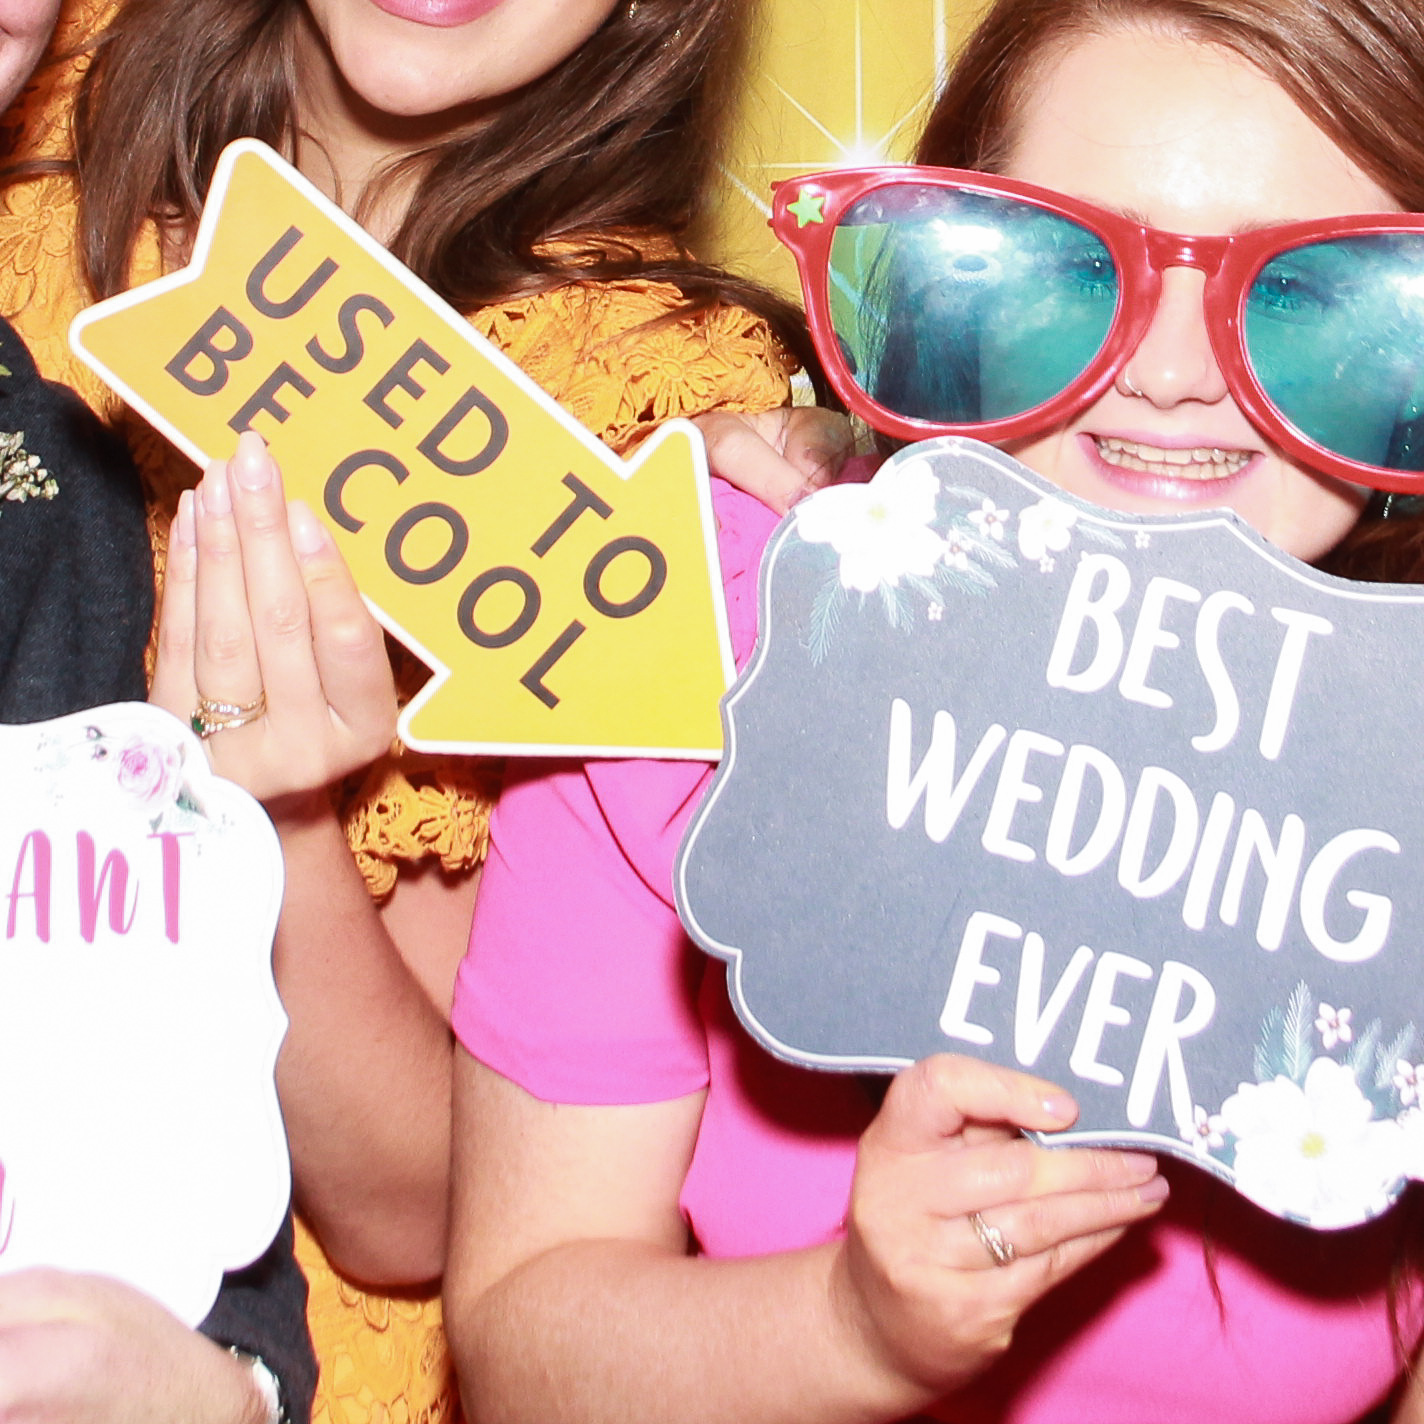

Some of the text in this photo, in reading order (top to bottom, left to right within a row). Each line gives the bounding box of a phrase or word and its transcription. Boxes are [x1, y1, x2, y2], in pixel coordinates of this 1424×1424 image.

[164, 305, 586, 710] BE COOL
[245, 226, 667, 618] USED TO
[1046, 553, 1333, 760] BEST
[886, 697, 1401, 962] WEDDING
[939, 911, 1216, 1142] EVER
